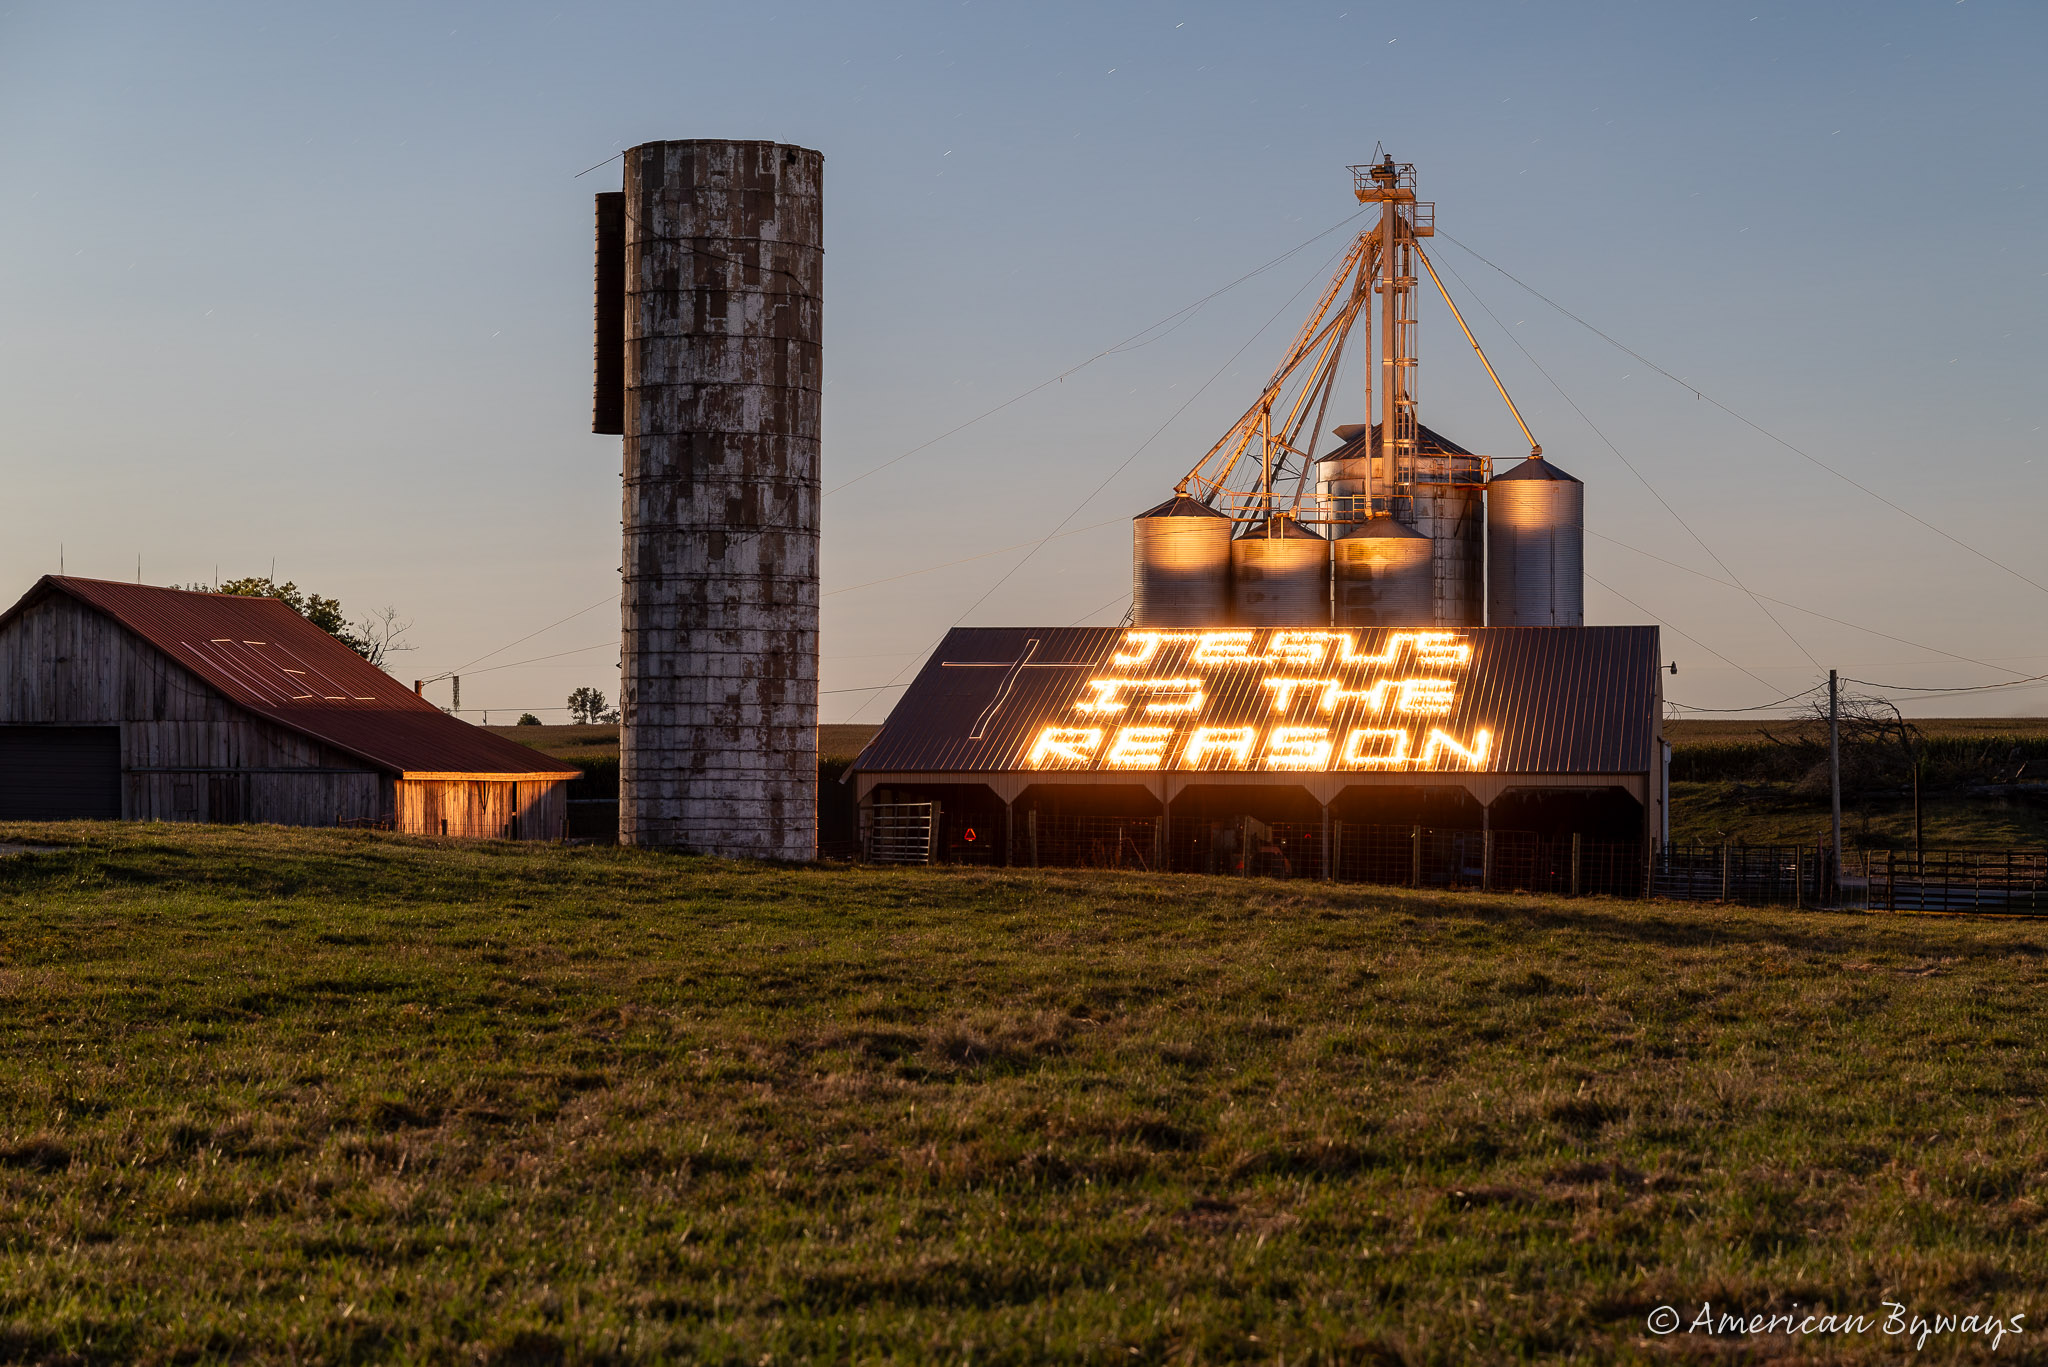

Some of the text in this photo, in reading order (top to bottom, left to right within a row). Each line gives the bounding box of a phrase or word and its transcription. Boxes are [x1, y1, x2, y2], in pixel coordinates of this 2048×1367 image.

[1113, 631, 1470, 665] JESUS
[1262, 676, 1457, 713] THE
[1029, 726, 1494, 766] REASON
